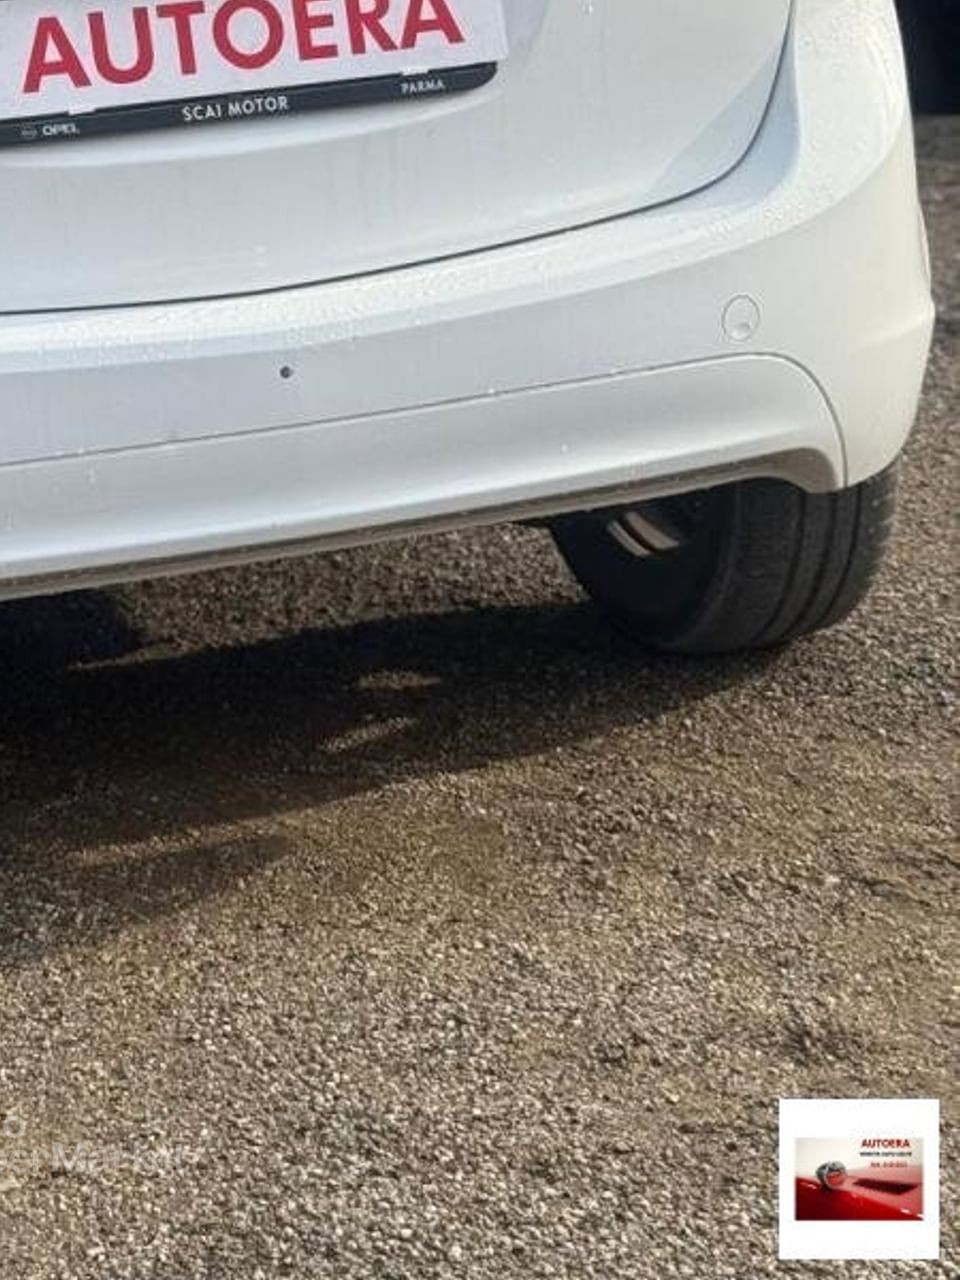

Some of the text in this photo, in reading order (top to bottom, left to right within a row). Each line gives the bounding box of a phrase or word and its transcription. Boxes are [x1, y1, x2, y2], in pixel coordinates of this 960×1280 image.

[400, 79, 445, 94] PARMA
[182, 96, 289, 121] SCAI MOTOR
[42, 123, 80, 136] OPEL
